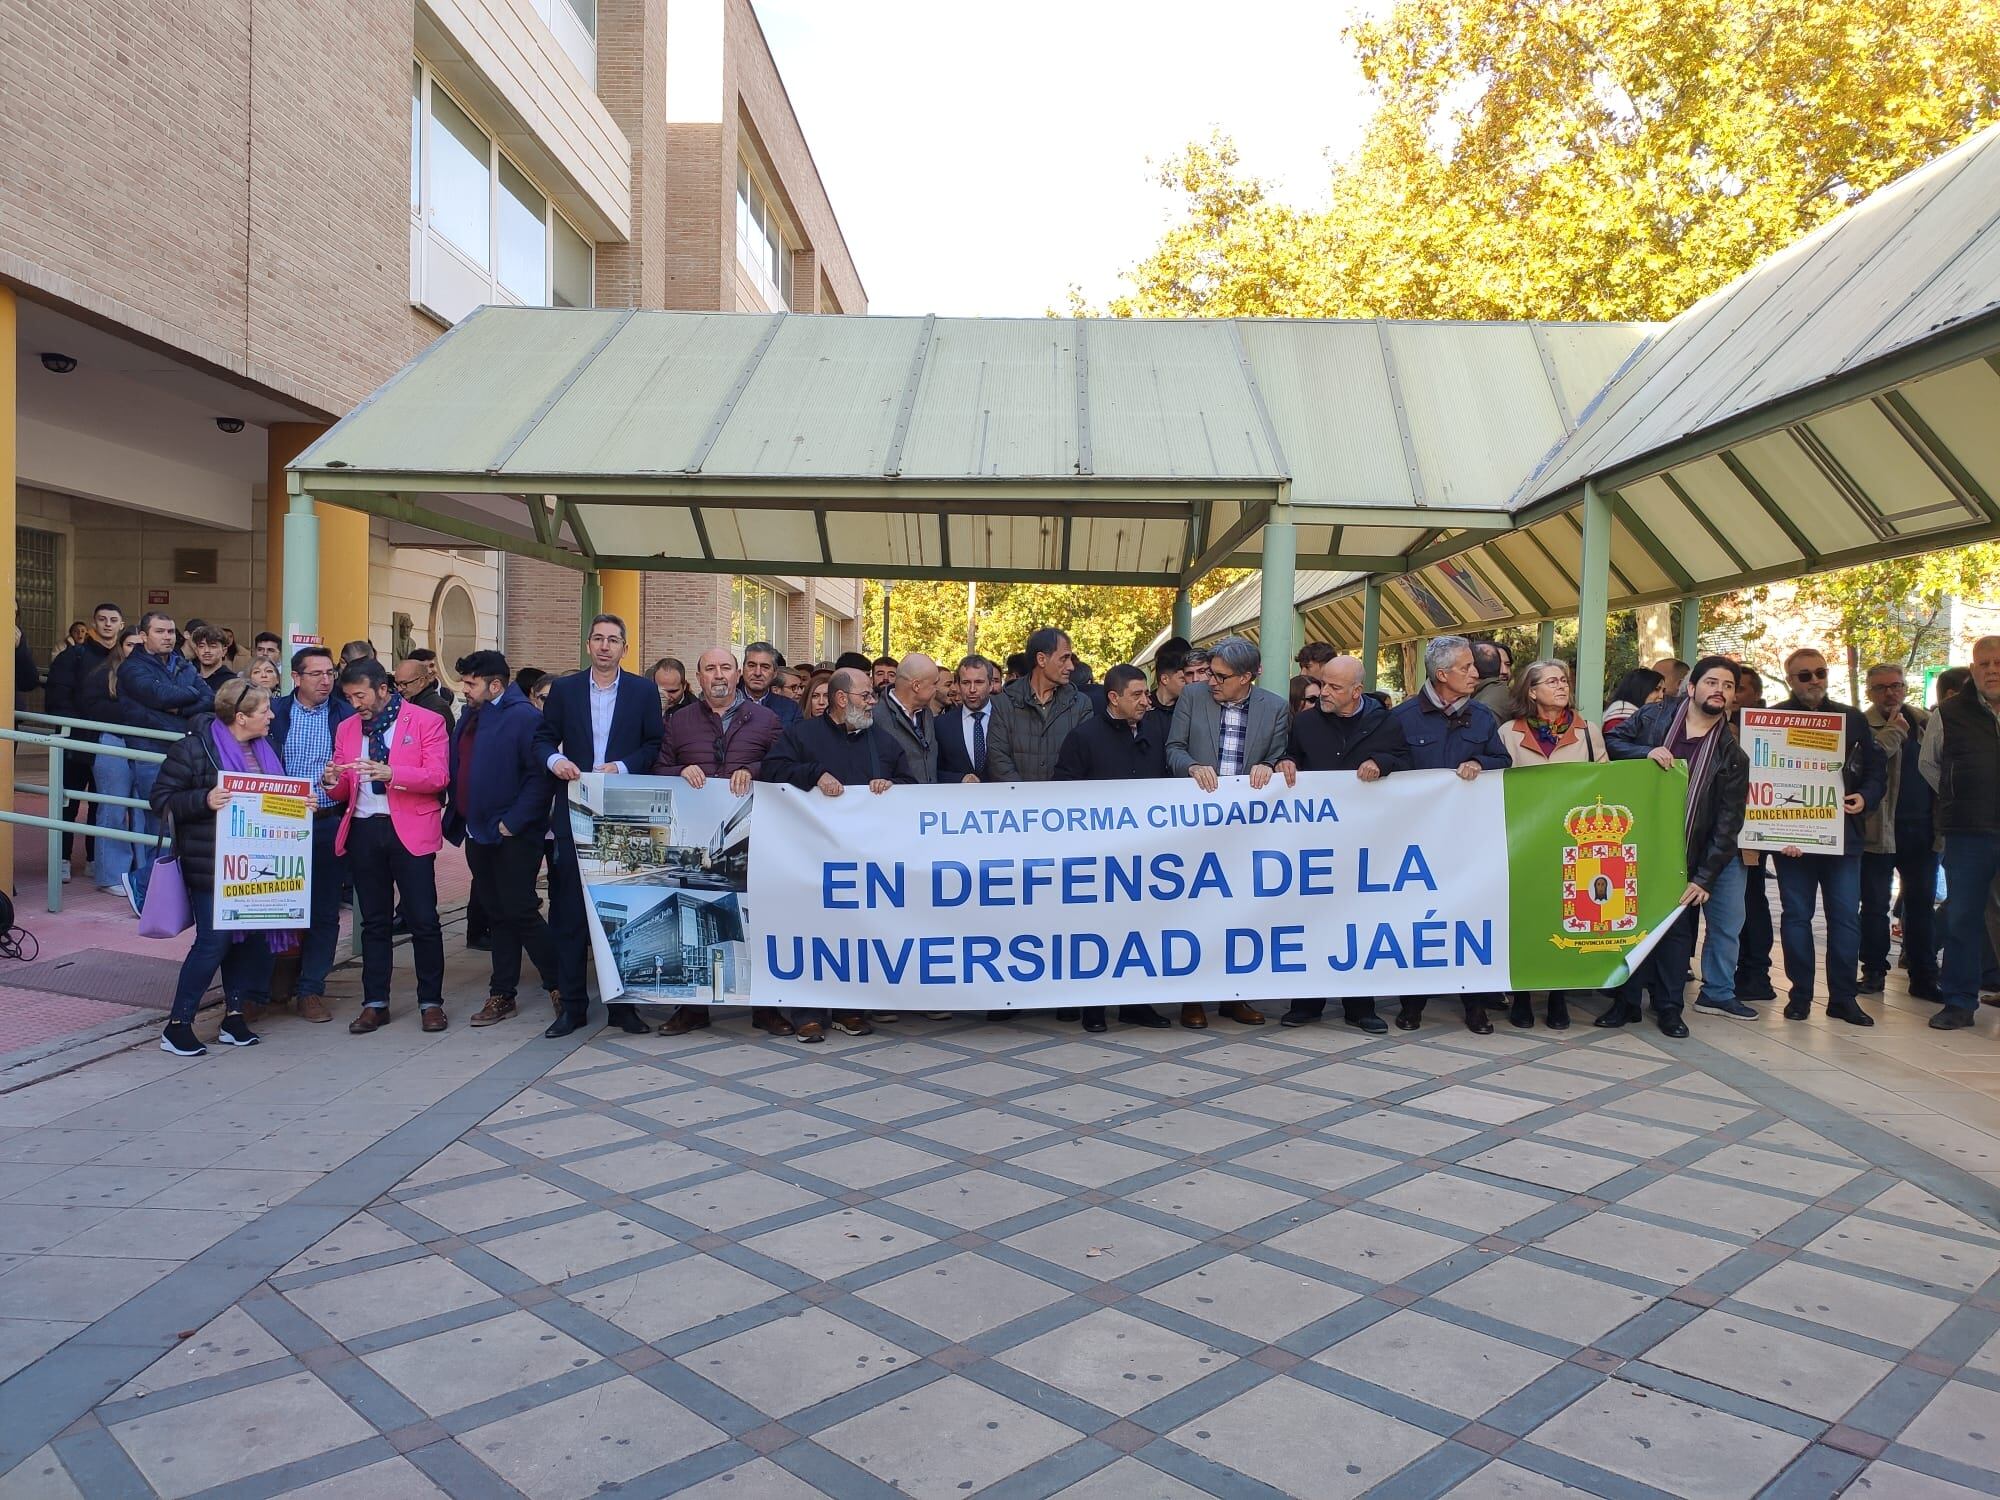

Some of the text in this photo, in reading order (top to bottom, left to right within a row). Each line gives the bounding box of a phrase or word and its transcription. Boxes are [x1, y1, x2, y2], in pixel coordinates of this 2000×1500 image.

[1769, 715, 1781, 726] LO
[1783, 716, 1831, 728] PERMITAS!
[227, 779, 301, 794] ¡NO LO PERMITAS!
[1746, 782, 1838, 810] NO UJA
[920, 799, 1339, 834] PLATAFORMA CIUDADANA
[223, 854, 305, 881] NO UJA
[823, 844, 1438, 909] EN DEFENSA DE LA
[226, 879, 301, 897] CONCENTRACIÓN
[766, 909, 1493, 985] UNIVERSIDAD DE JAÉN
